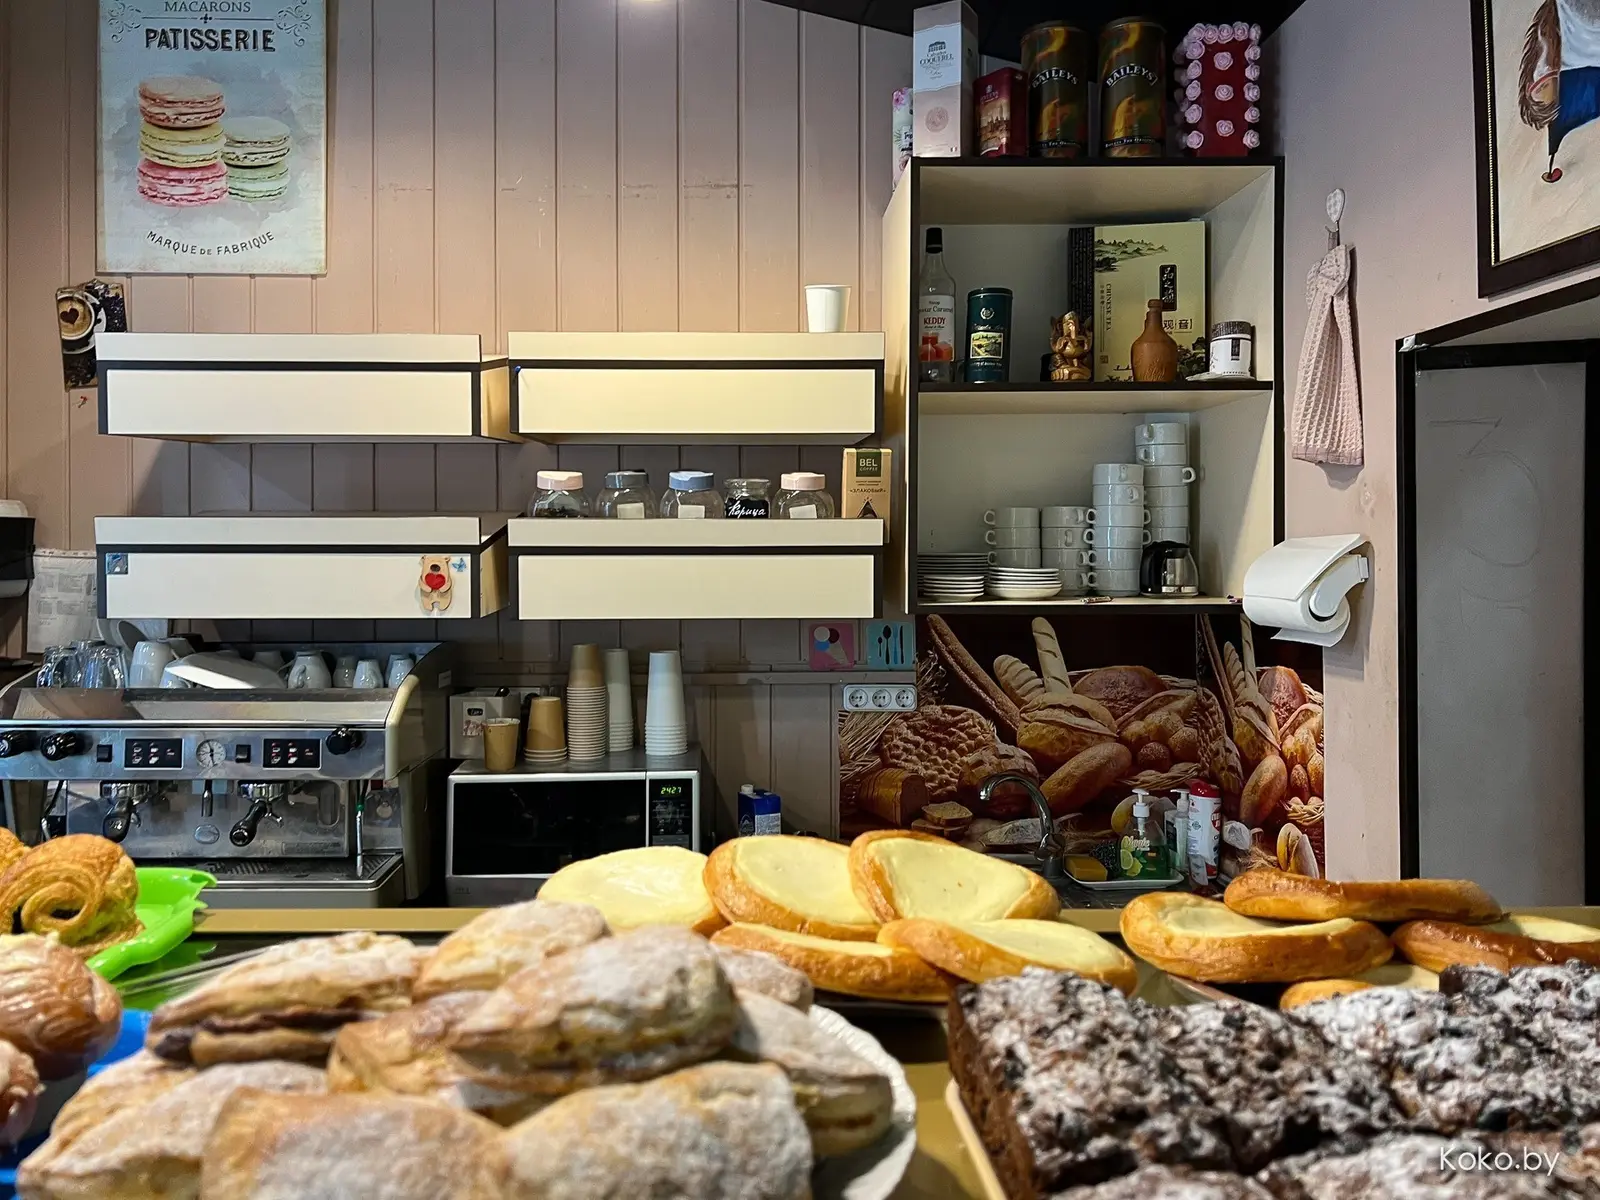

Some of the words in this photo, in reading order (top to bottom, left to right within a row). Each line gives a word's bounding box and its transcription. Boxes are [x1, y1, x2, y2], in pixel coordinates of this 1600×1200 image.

[164, 1, 251, 13] MACARONS
[145, 28, 276, 52] PATISSERIE
[1032, 69, 1079, 88] BAILEYS
[1105, 65, 1153, 86] BAILEYS
[146, 231, 197, 255] MARQUE
[200, 248, 213, 256] DE
[217, 231, 275, 256] FABRIQUE
[923, 317, 946, 325] KEDDY
[859, 458, 878, 467] BEL
[728, 500, 766, 519] Корица
